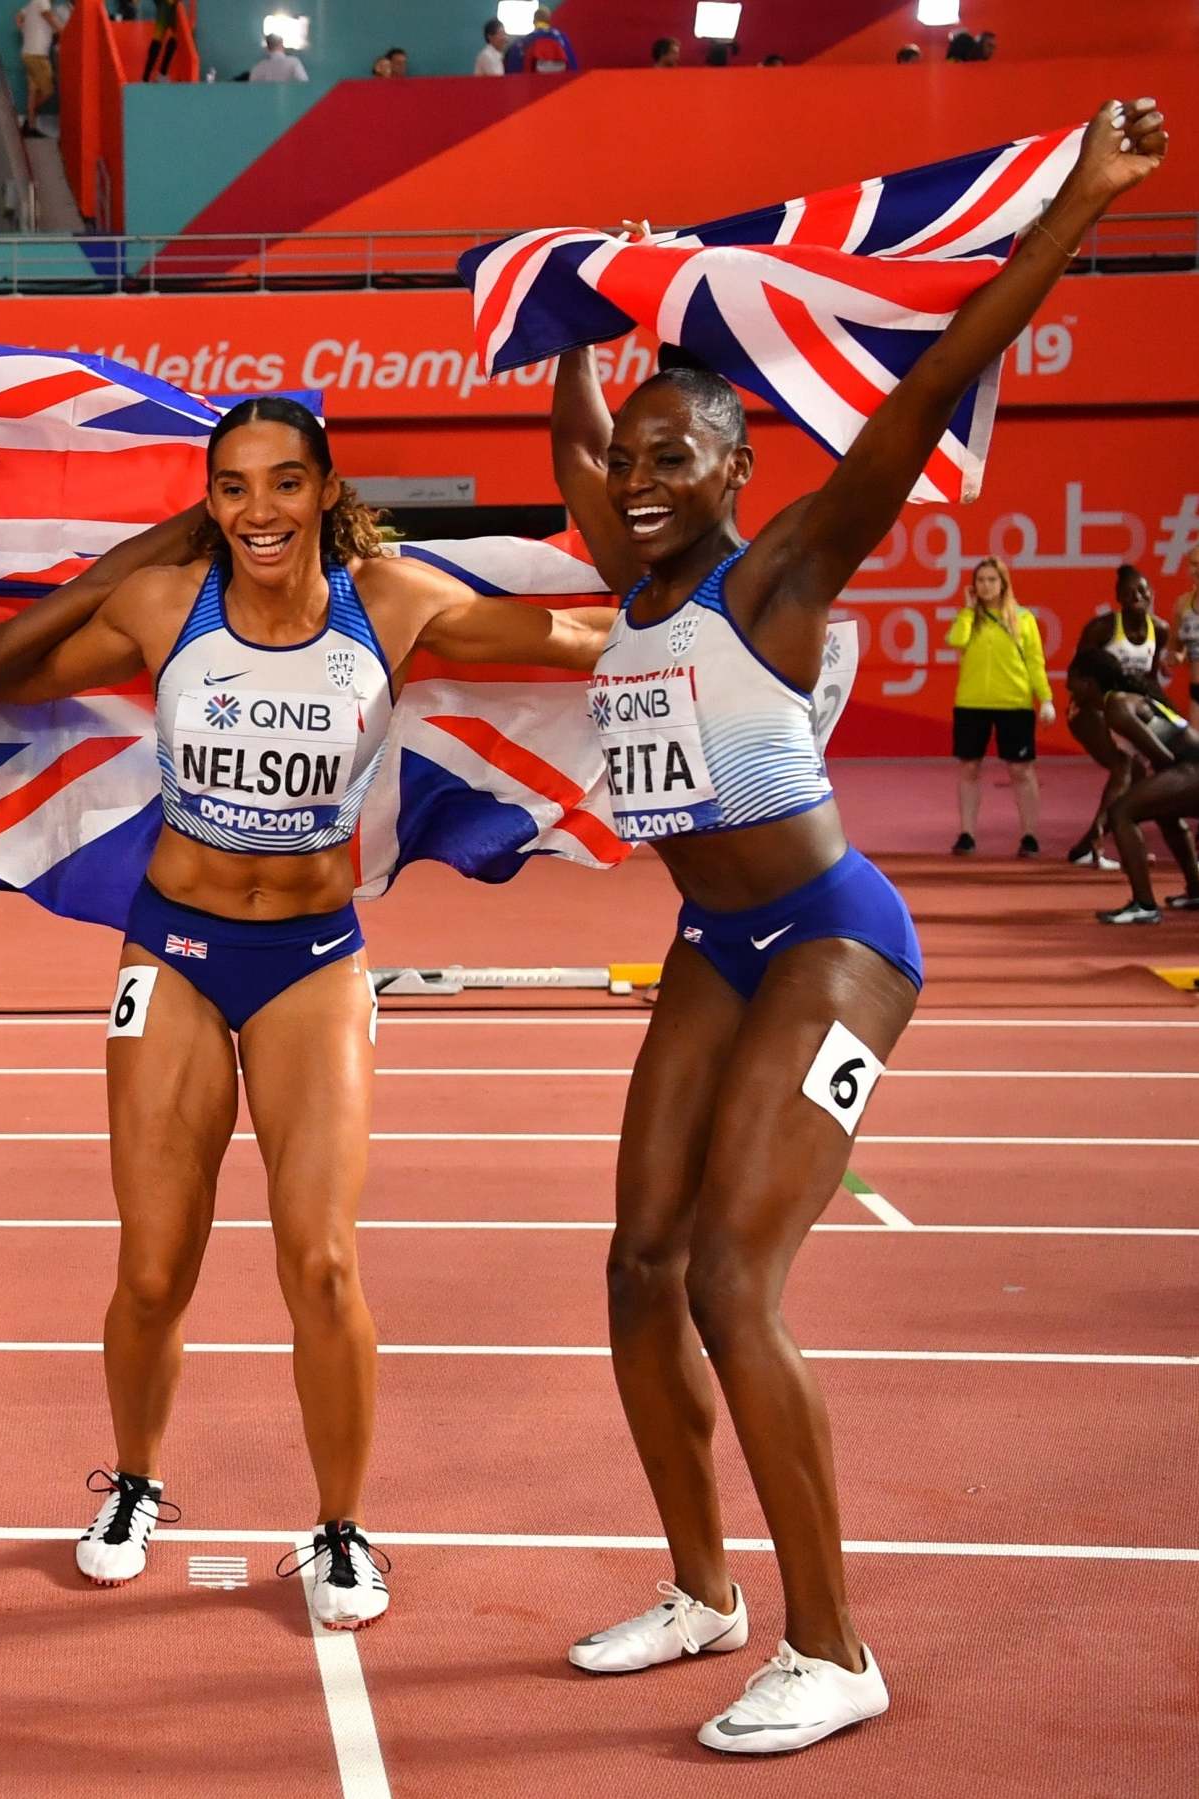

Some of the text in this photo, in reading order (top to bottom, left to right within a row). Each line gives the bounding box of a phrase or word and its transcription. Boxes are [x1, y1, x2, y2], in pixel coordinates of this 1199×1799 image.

[65, 340, 285, 391] hletics
[1012, 323, 1074, 376] 19
[250, 700, 331, 731] QNB
[616, 689, 670, 721] QNB
[182, 743, 341, 798] NELSON
[603, 741, 696, 796] EITA
[200, 799, 315, 832] DOHA2019
[617, 811, 694, 839] HA2019
[114, 977, 139, 1028] 6
[829, 1057, 866, 1109] 6
